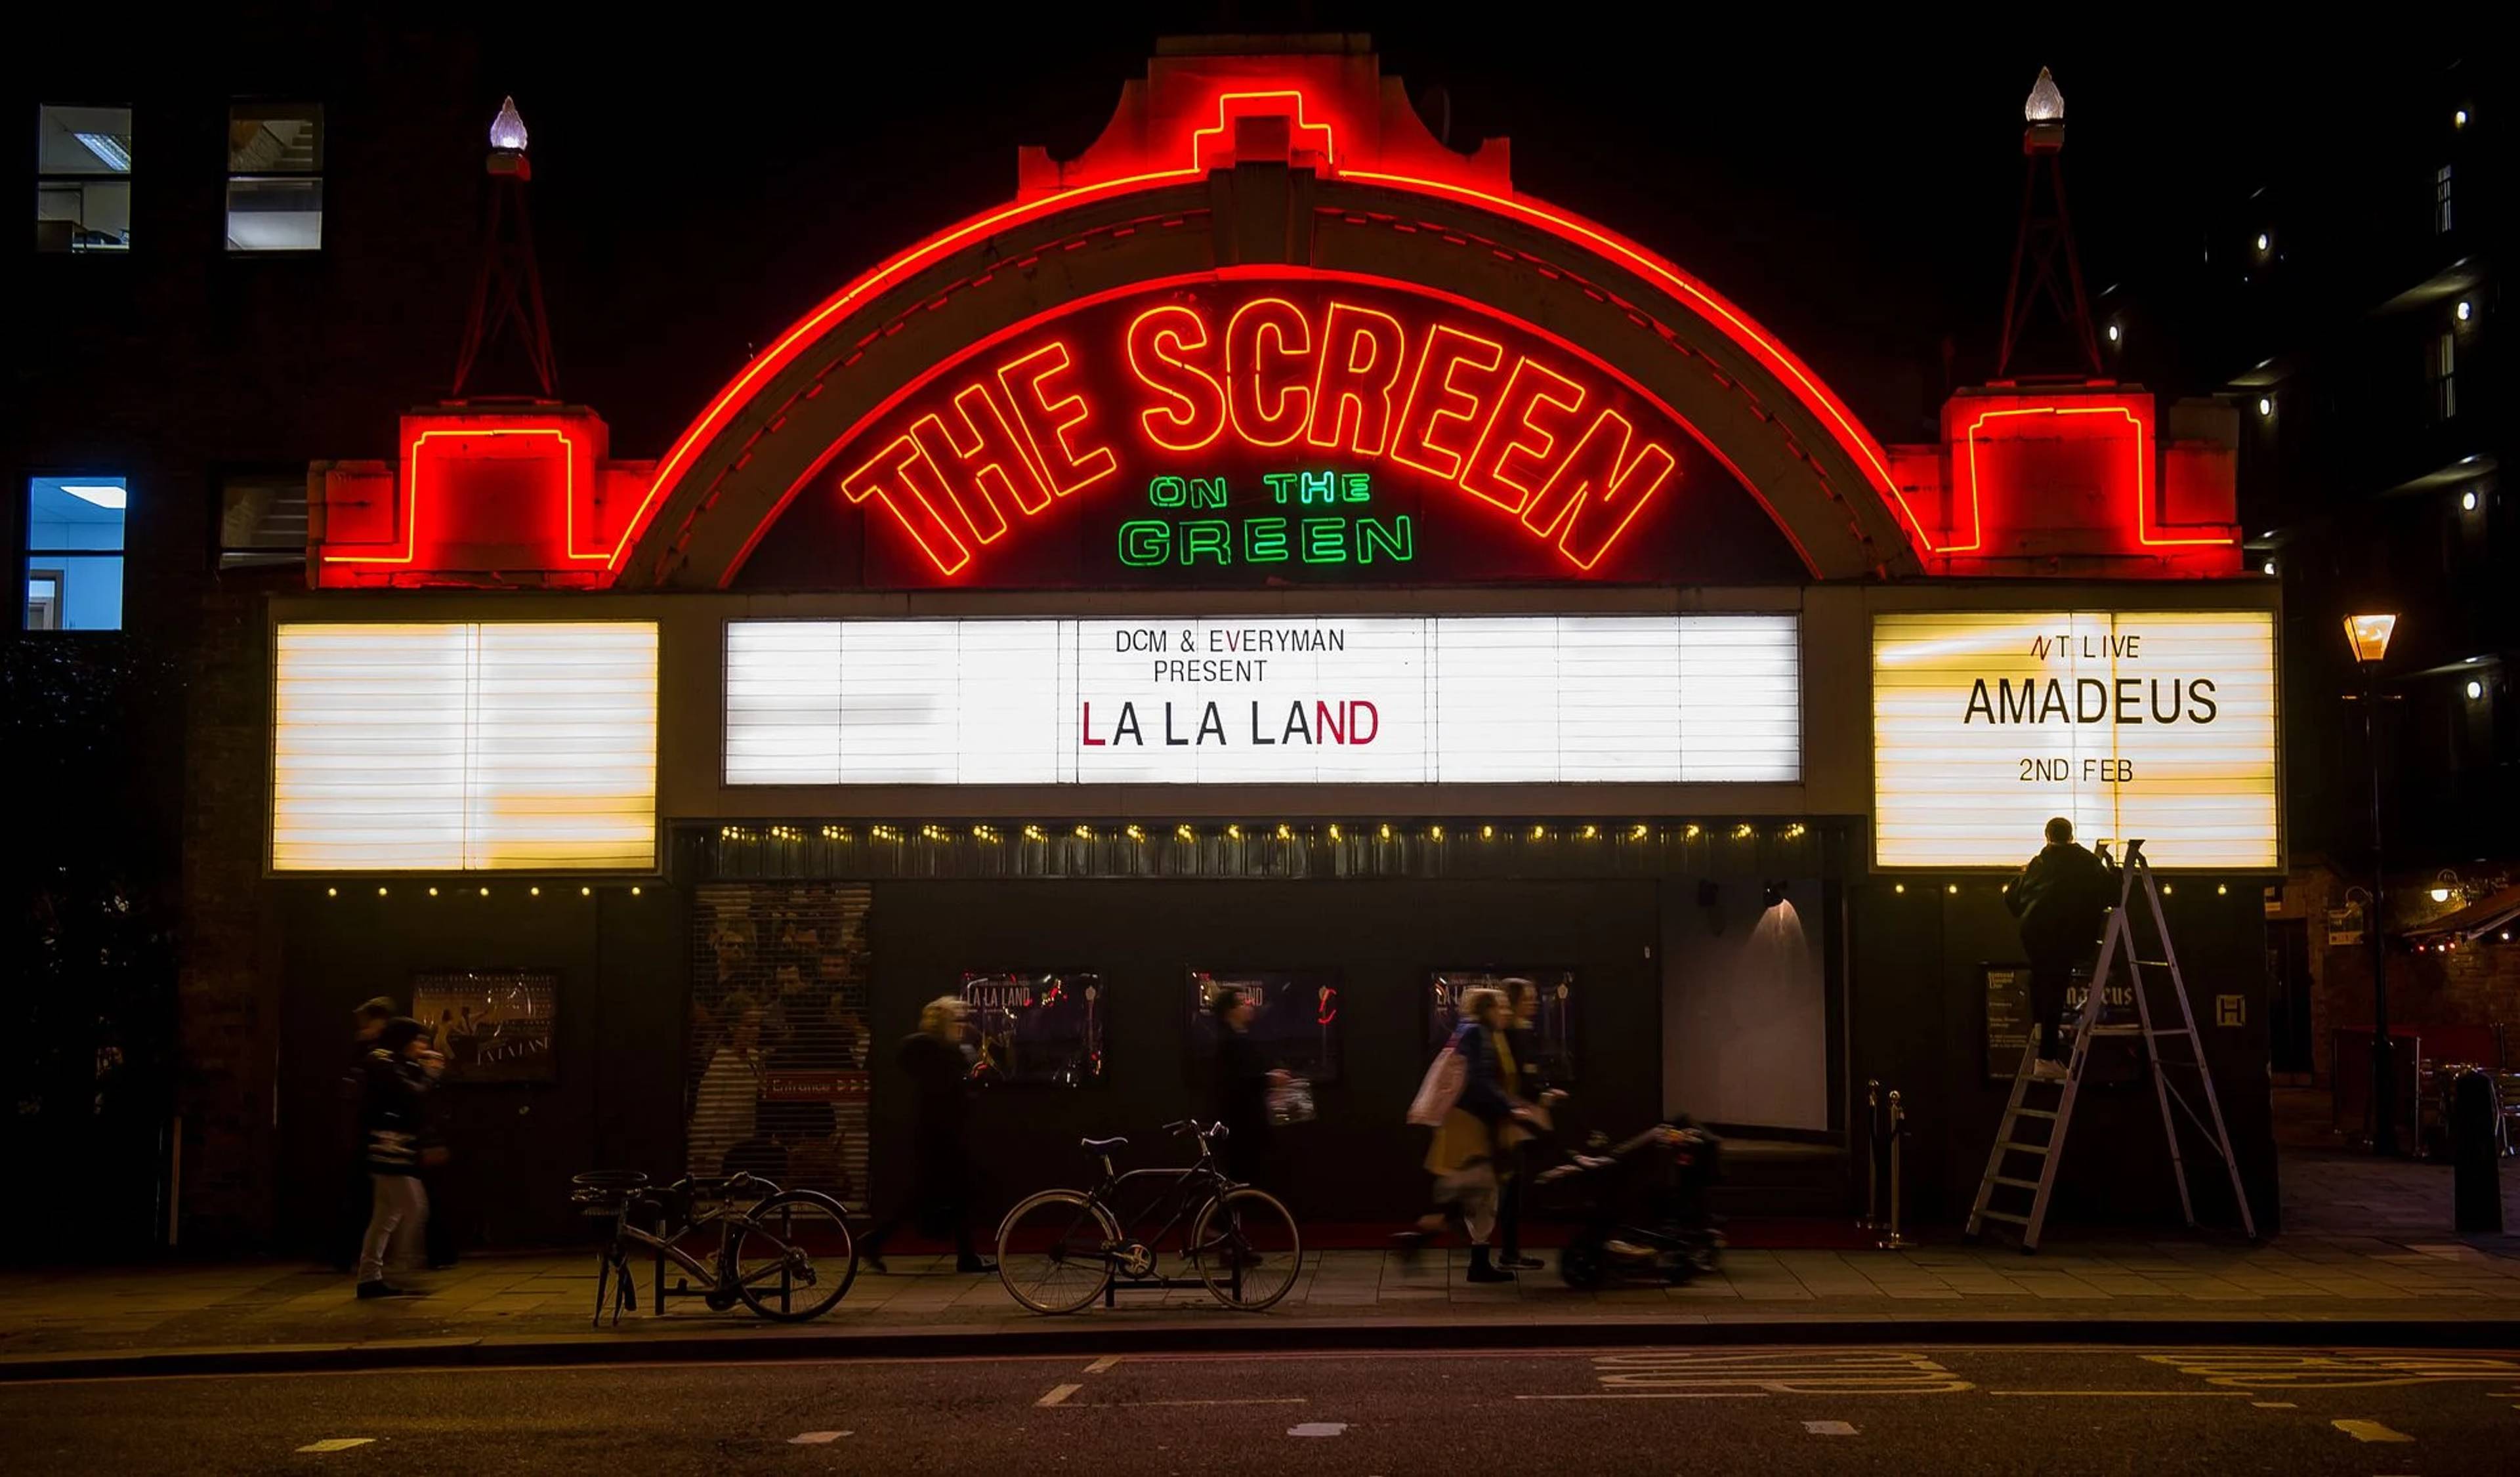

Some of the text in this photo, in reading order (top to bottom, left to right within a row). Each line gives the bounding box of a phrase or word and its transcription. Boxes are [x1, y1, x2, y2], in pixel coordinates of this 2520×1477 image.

[841, 297, 1677, 575] THE SCREEN
[1149, 470, 1372, 510] ON THE
[1118, 514, 1414, 566] GREEN
[1116, 629, 1345, 653] DCM & EVERYMAN
[2030, 634, 2141, 661] NT LIVE
[1154, 659, 1268, 682] PRESENT
[1963, 678, 2218, 725] AMADEUS
[1083, 700, 1379, 747] LA LA LAND
[2019, 757, 2133, 783] 2ND FEB
[967, 986, 1030, 1007] LA LA LAND
